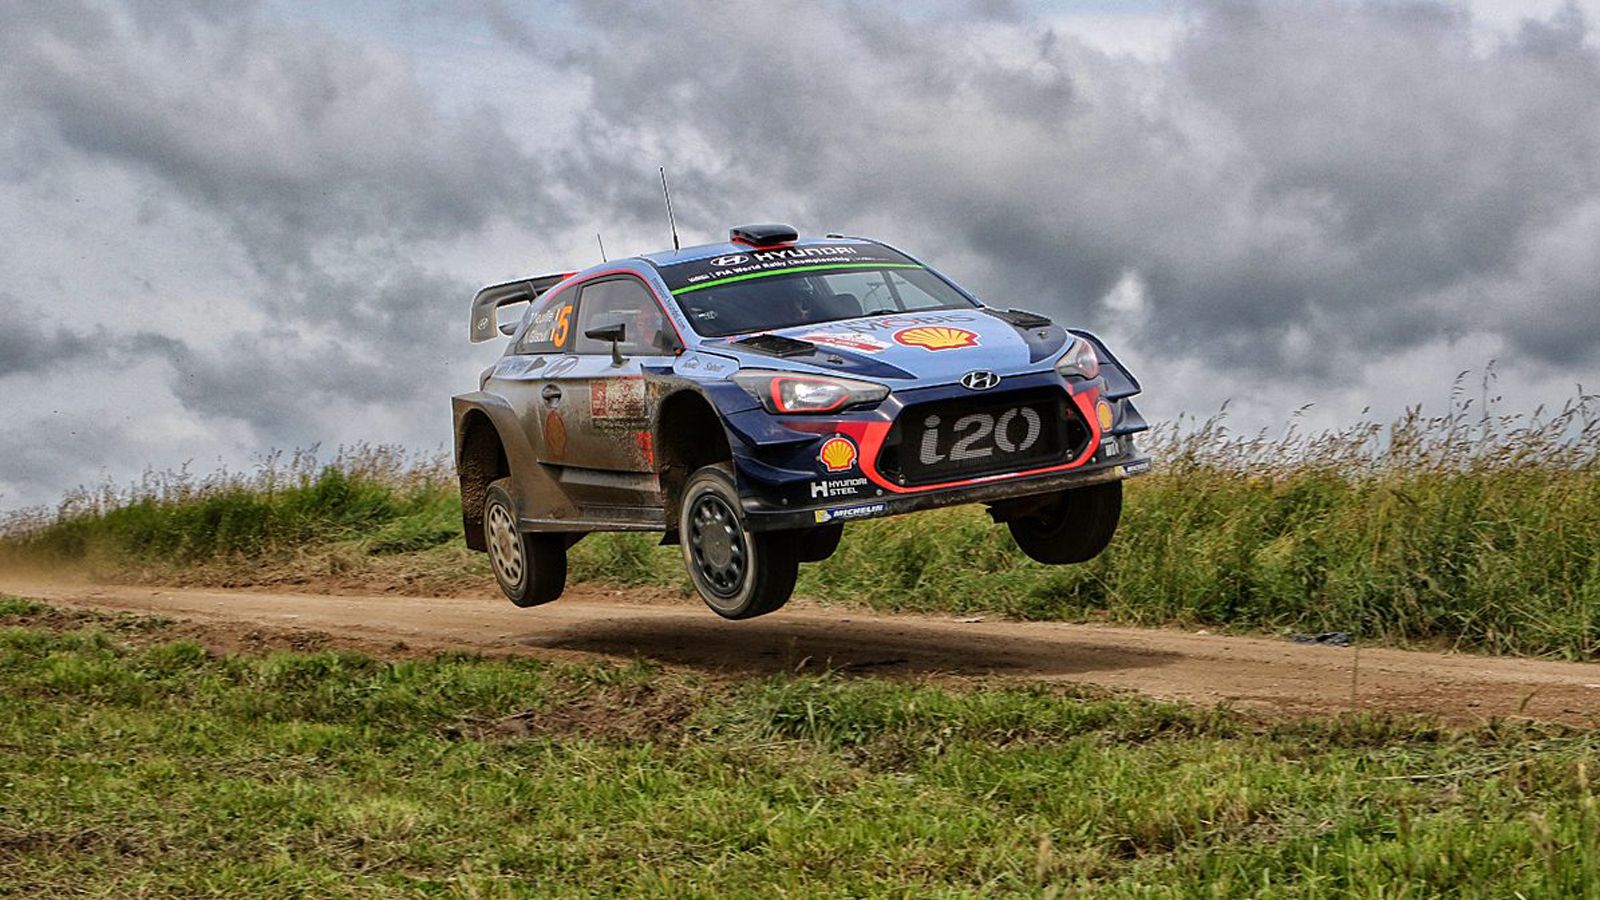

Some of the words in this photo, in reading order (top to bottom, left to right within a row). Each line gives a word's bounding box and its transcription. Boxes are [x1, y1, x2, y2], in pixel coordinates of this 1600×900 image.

[753, 246, 857, 262] HYUNDAI
[715, 268, 733, 277] FIA
[733, 263, 762, 273] World
[762, 260, 786, 269] Rally
[788, 256, 850, 266] Championship
[920, 406, 1041, 465] i20
[828, 478, 868, 488] HYUNDAI
[829, 487, 859, 496] STEEL
[833, 504, 884, 518] MICHELIN
